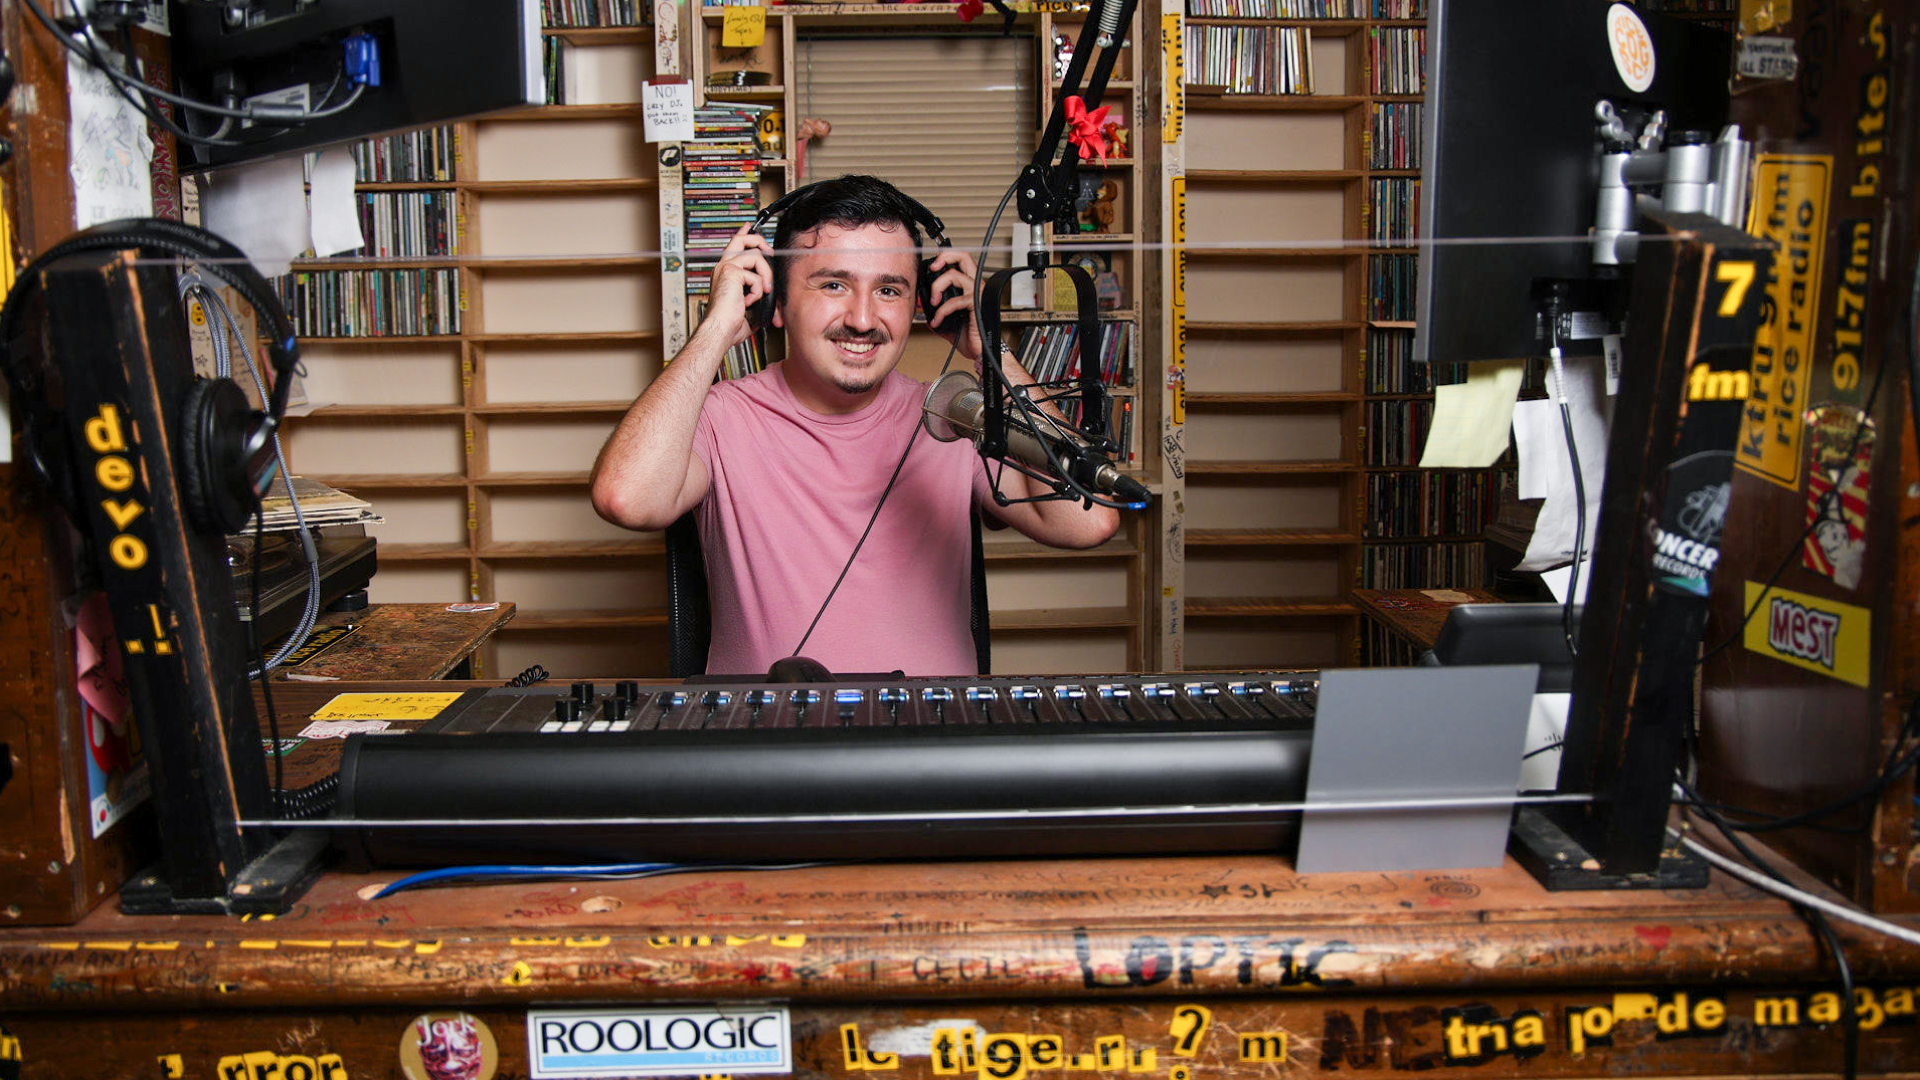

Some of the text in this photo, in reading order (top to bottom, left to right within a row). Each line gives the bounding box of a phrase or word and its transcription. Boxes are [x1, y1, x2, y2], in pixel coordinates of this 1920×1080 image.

[655, 86, 677, 98] NO!
[1717, 261, 1756, 316] 7
[1771, 198, 1817, 447] rice radio
[1690, 364, 1749, 400] fm
[1741, 345, 1775, 460] ktru
[541, 1015, 778, 1053] ROOLOGIC
